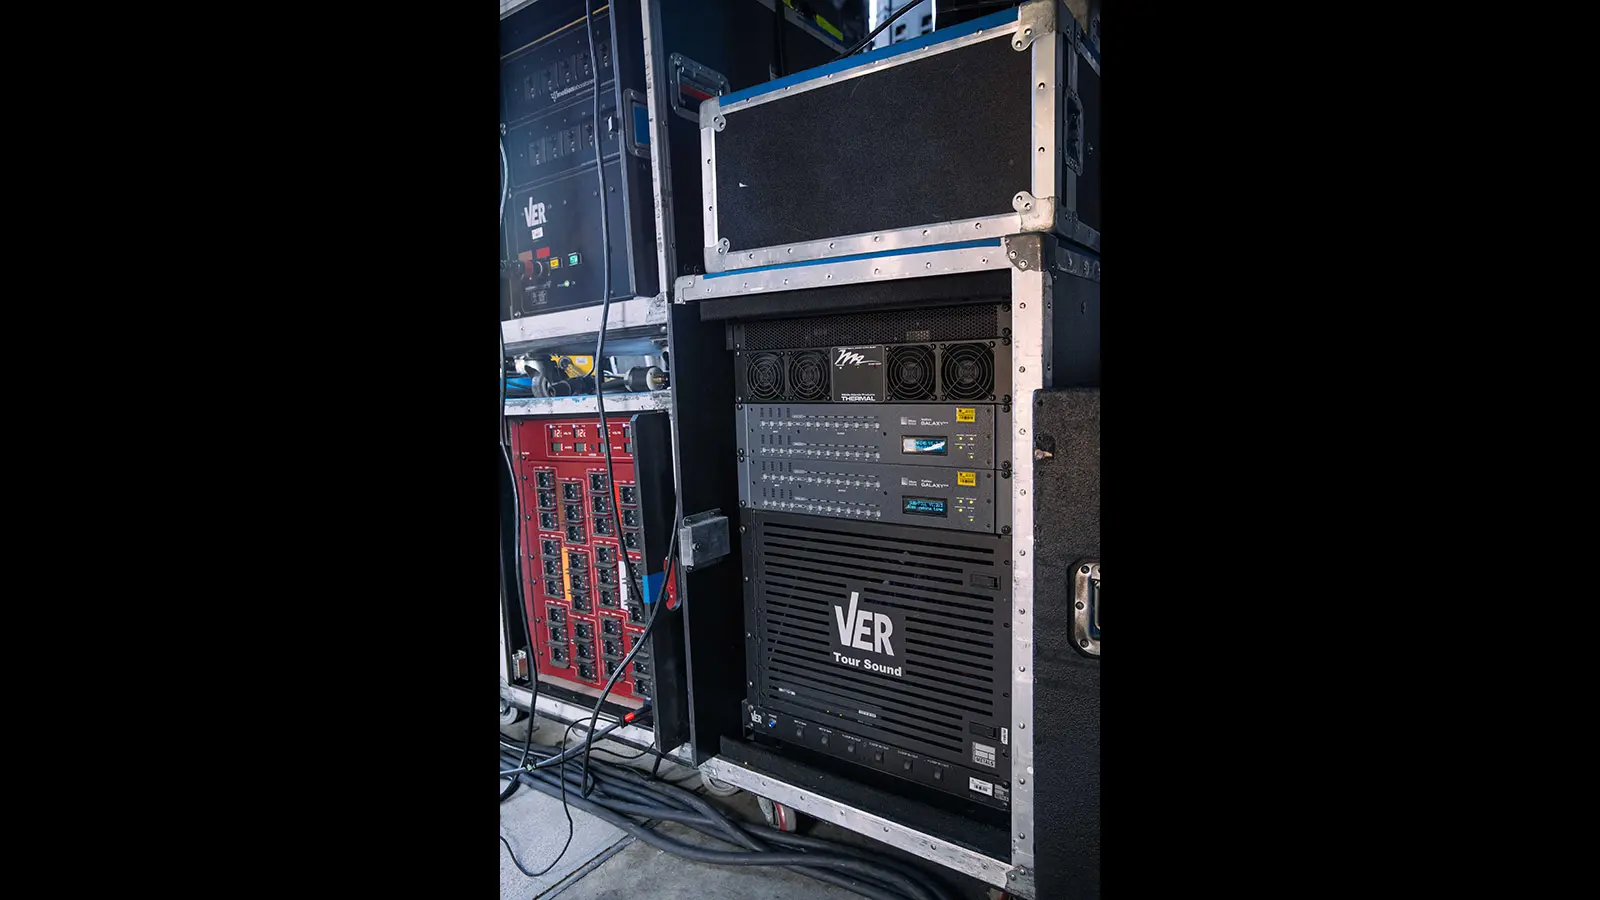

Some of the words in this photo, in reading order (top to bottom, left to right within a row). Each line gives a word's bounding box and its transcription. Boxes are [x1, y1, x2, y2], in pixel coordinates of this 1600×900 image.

[524, 196, 547, 228] VER
[834, 591, 895, 657] VER
[833, 651, 861, 667] Tour
[863, 659, 902, 677] Sound
[750, 710, 763, 724] VER
